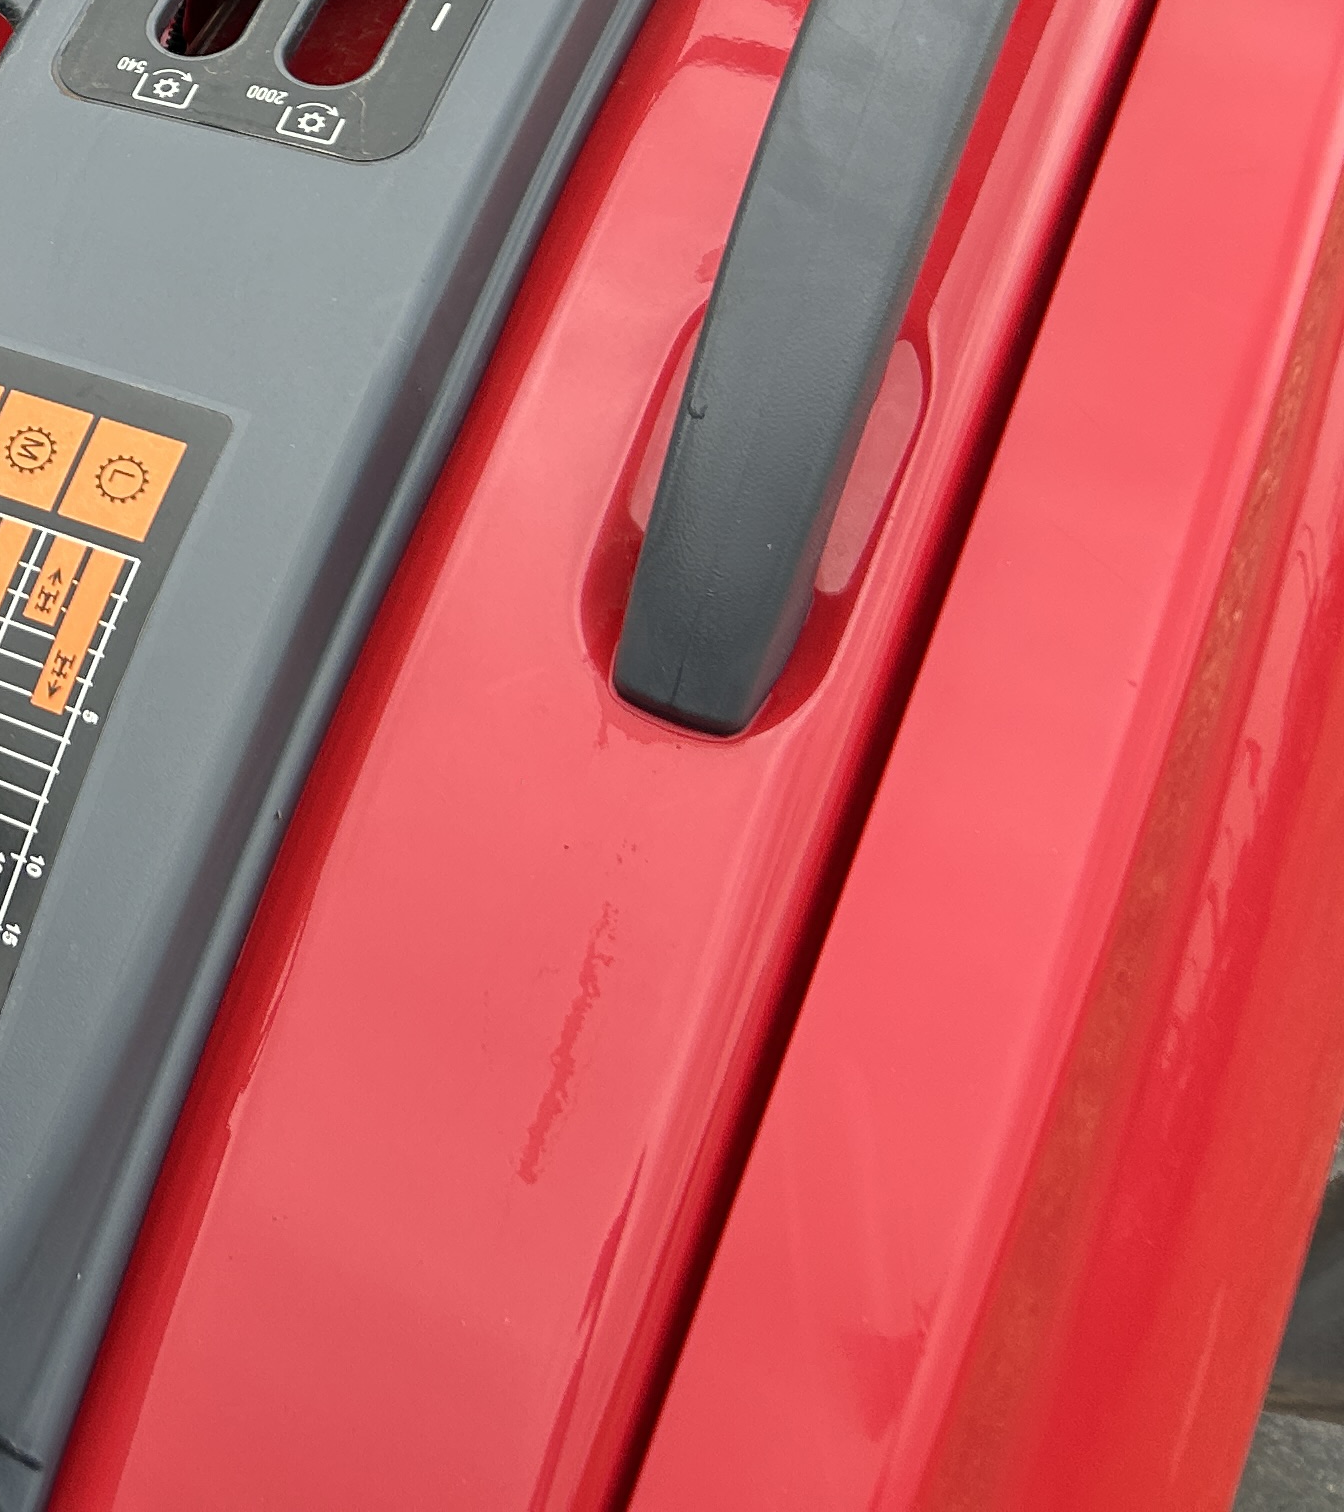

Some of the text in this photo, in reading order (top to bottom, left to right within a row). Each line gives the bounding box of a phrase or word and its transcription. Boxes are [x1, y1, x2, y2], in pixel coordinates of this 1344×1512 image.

[116, 56, 148, 74] 540
[246, 84, 289, 105] 2000
[16, 436, 45, 463] M
[108, 468, 136, 483] L
[81, 709, 100, 726] 5
[25, 853, 46, 879] 10
[1, 922, 22, 949] 15
